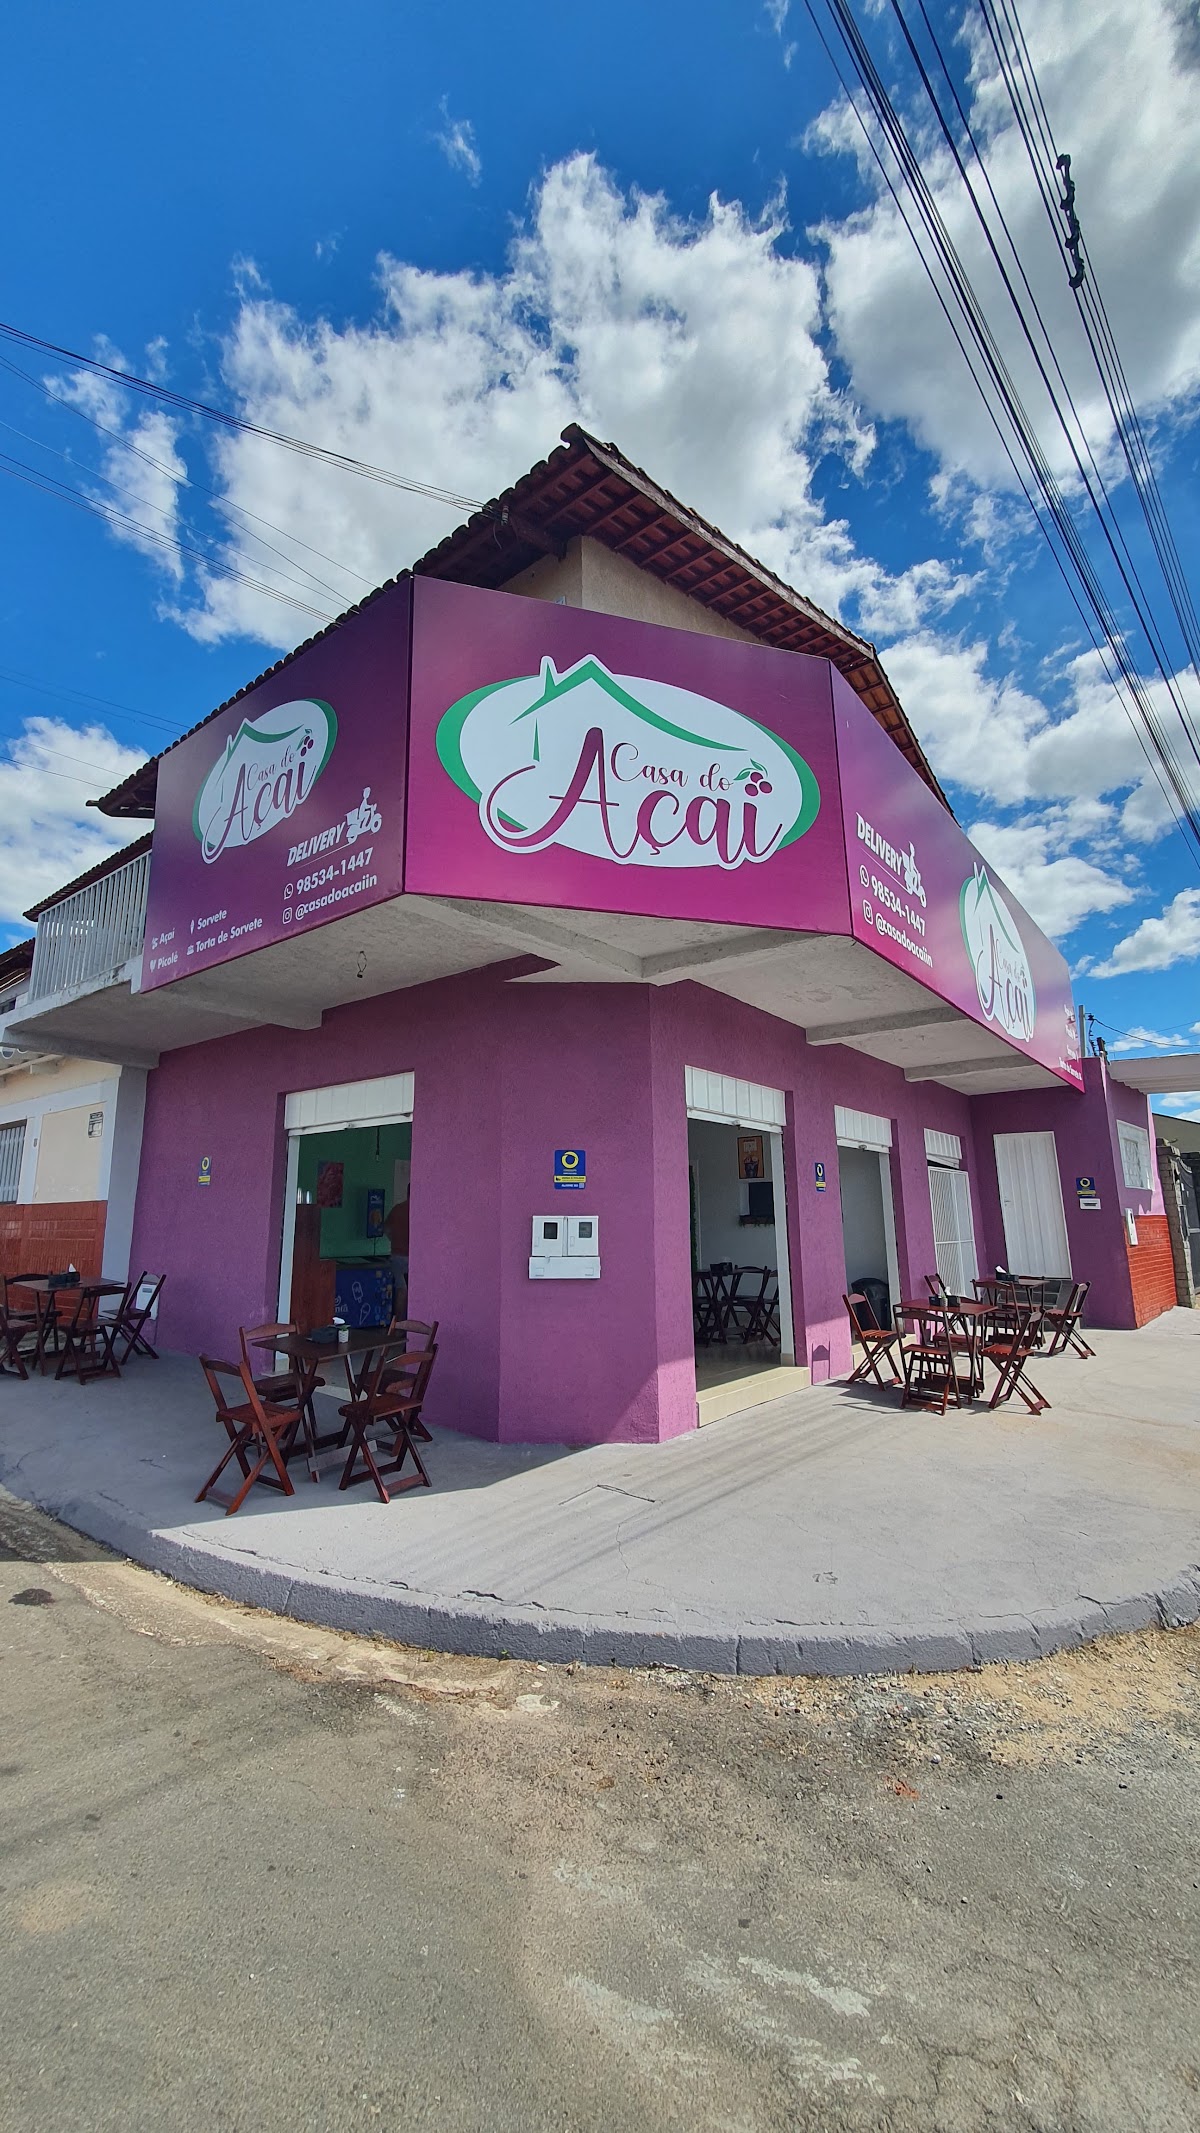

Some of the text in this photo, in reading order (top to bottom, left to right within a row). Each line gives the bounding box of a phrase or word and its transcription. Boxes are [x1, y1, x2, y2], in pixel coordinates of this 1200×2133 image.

[247, 748, 295, 791] Casa do
[610, 742, 734, 791] Casa do
[287, 821, 346, 867] DELIVERY
[855, 812, 903, 876] DELIVERY
[296, 847, 374, 895] 98534-1447
[197, 909, 228, 930] Sorvete
[295, 873, 378, 921] @casadoacaiin
[870, 875, 926, 937] 98534-1447
[159, 927, 176, 946] Açaí
[195, 917, 263, 953] Torta de Sorvete
[875, 912, 933, 969] @casadoacaiin
[157, 951, 179, 970] Picolé
